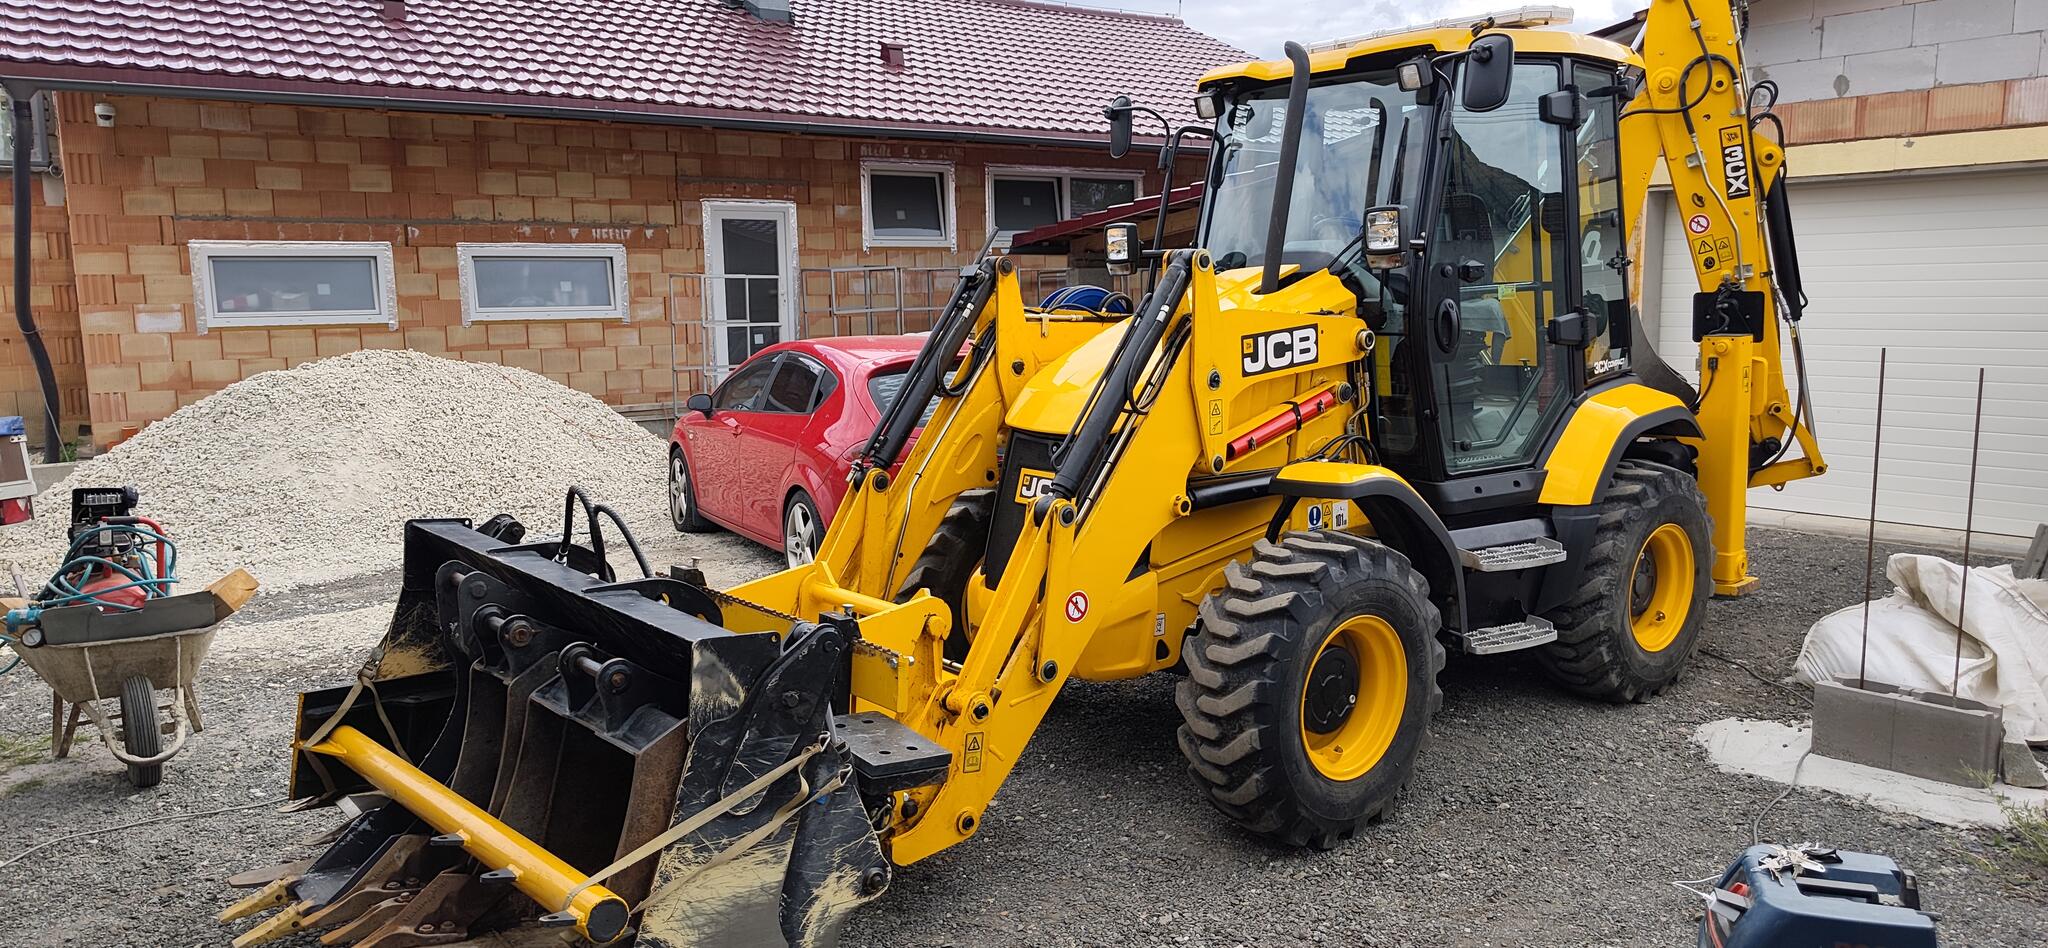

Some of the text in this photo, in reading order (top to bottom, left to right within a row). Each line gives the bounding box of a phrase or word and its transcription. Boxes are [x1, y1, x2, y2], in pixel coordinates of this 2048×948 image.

[1724, 146, 1749, 193] 3CX
[1243, 328, 1317, 373] JCB
[1593, 359, 1609, 375] 3CX
[1021, 476, 1054, 497] JC
